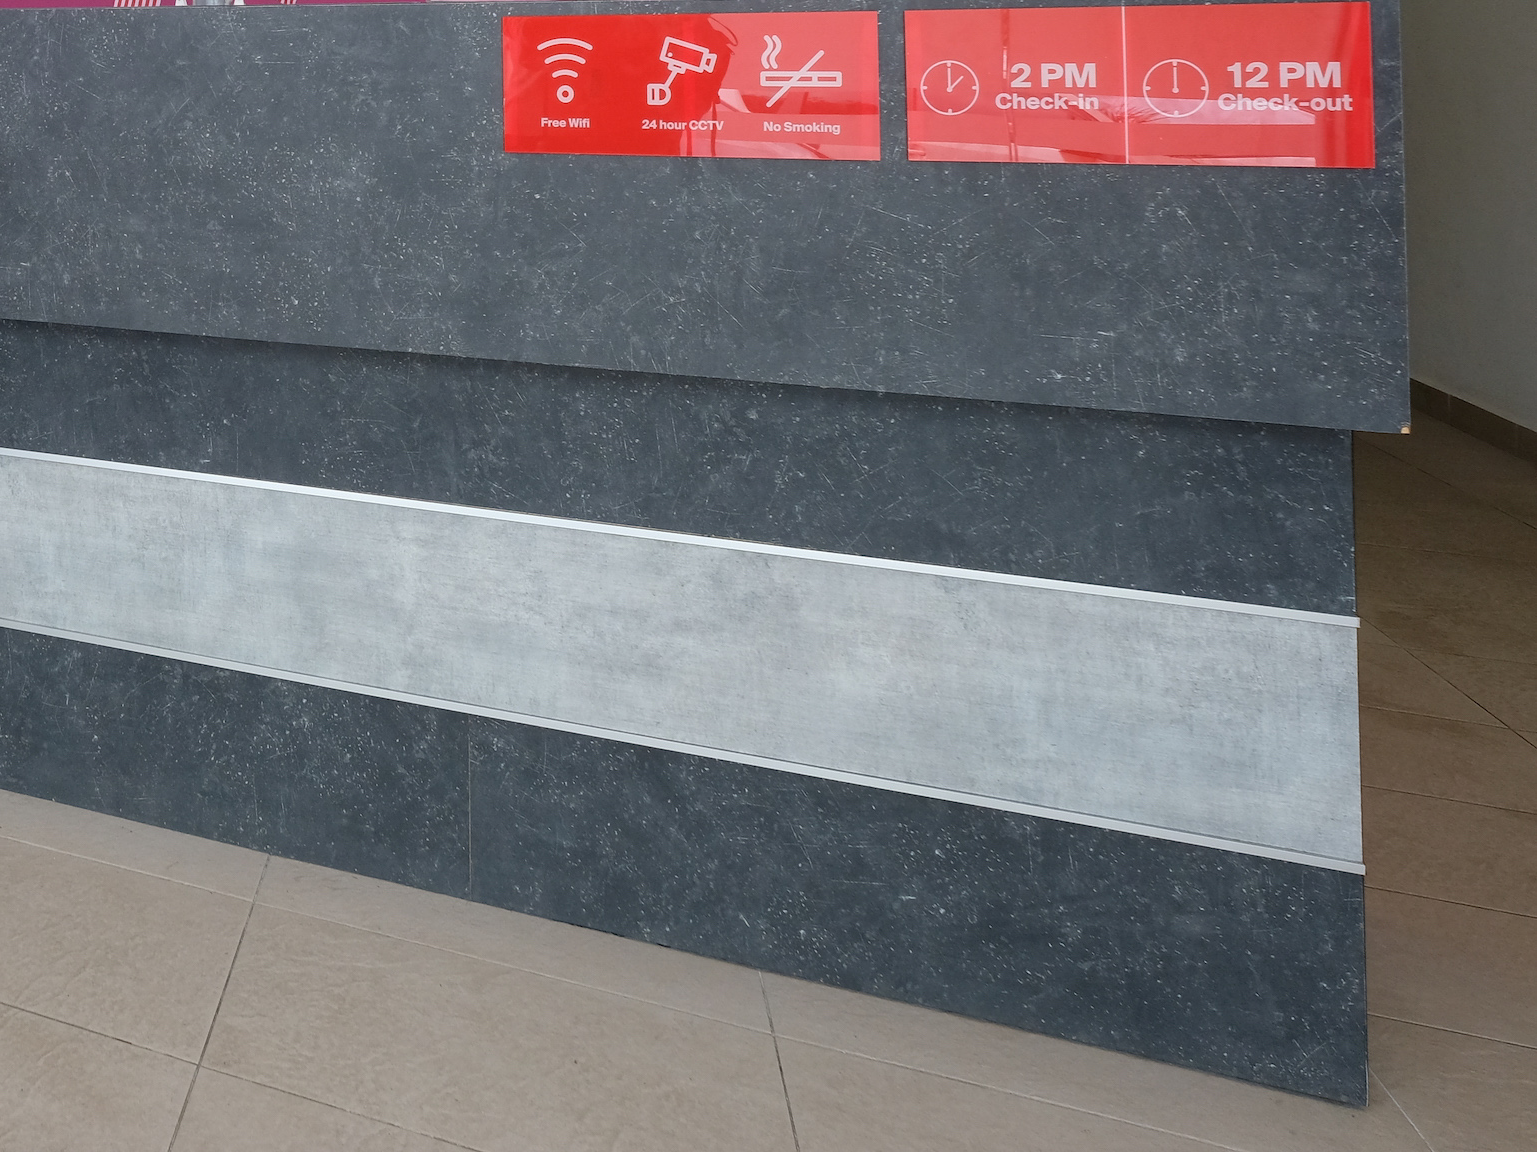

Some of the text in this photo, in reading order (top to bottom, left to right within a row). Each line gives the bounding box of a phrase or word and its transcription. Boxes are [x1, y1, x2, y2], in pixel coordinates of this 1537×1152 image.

[1010, 63, 1097, 88] 2 PM
[1227, 62, 1342, 88] 12 PM
[994, 93, 1099, 111] Check-in
[1218, 93, 1353, 113] Check-out
[540, 117, 590, 128] Free Wifi
[641, 119, 724, 131] 24 hour CCTV
[763, 121, 841, 135] No Smoking
